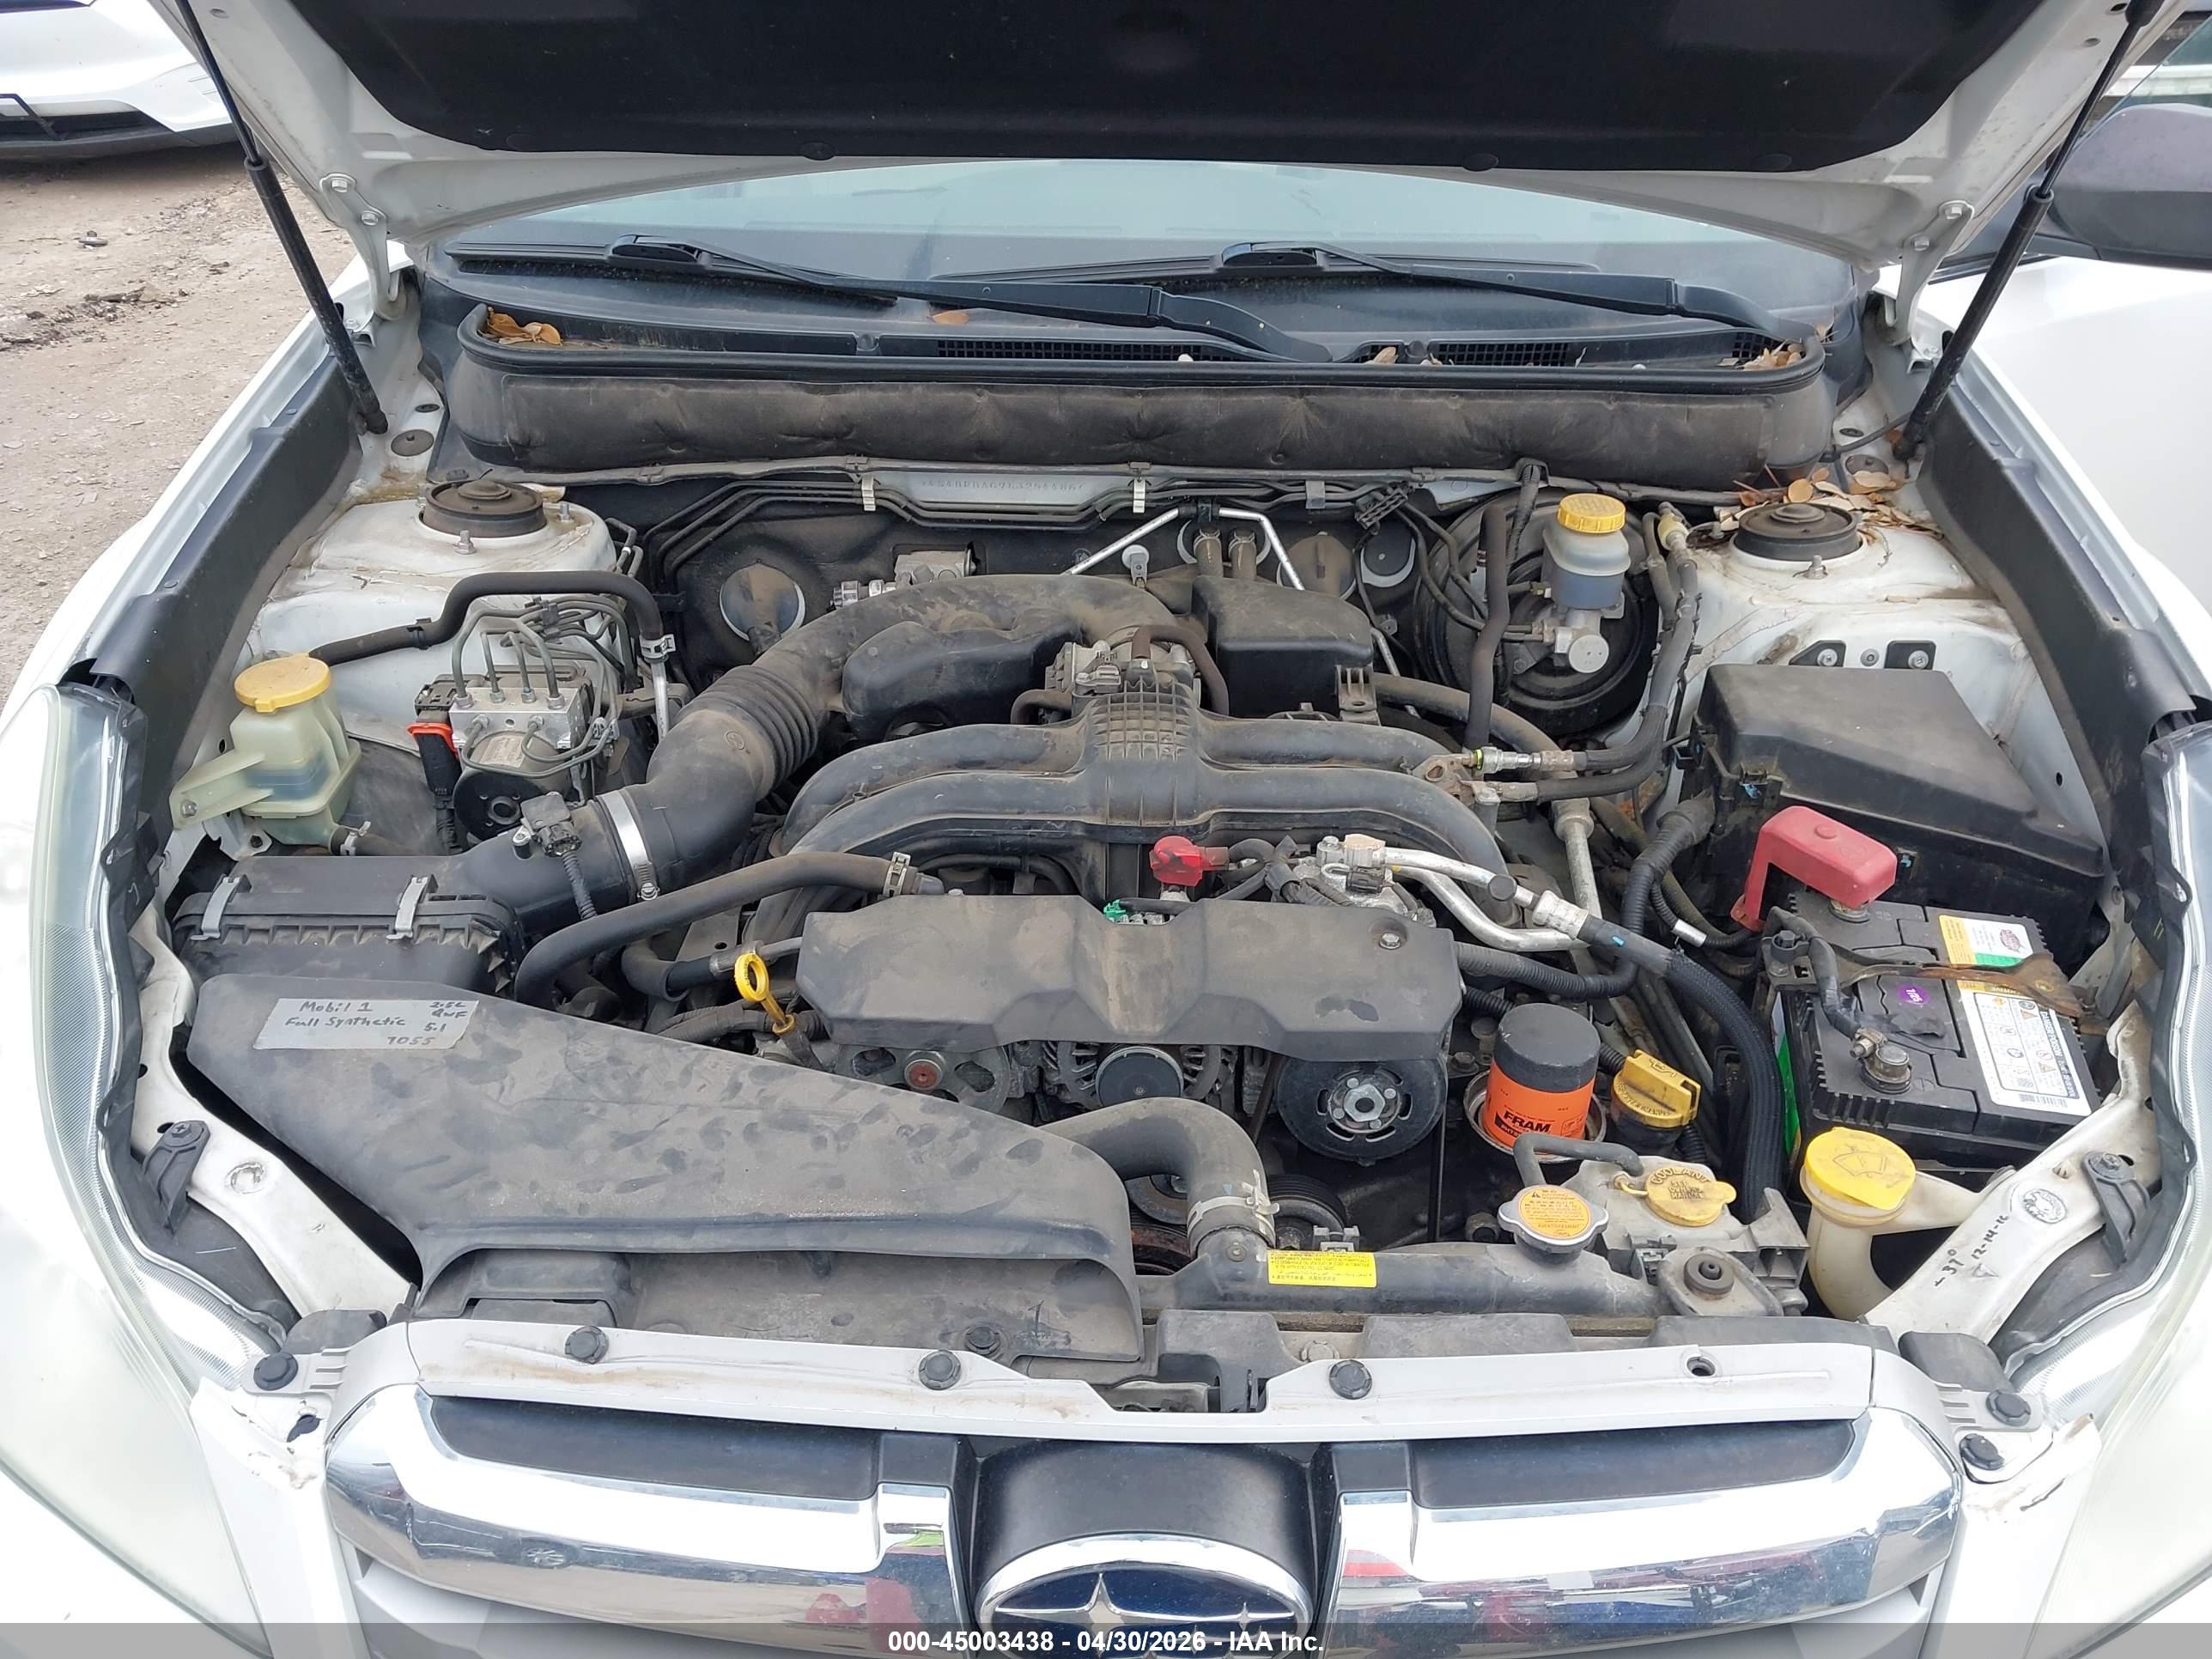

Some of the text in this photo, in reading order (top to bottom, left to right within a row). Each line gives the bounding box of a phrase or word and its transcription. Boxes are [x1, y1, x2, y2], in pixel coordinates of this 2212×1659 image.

[299, 1001, 374, 1013] Mobil 1
[285, 1016, 405, 1028] Full Synthetic
[1503, 1110, 1553, 1133] FRAM
[1650, 1168, 1711, 1185] COOLANT
